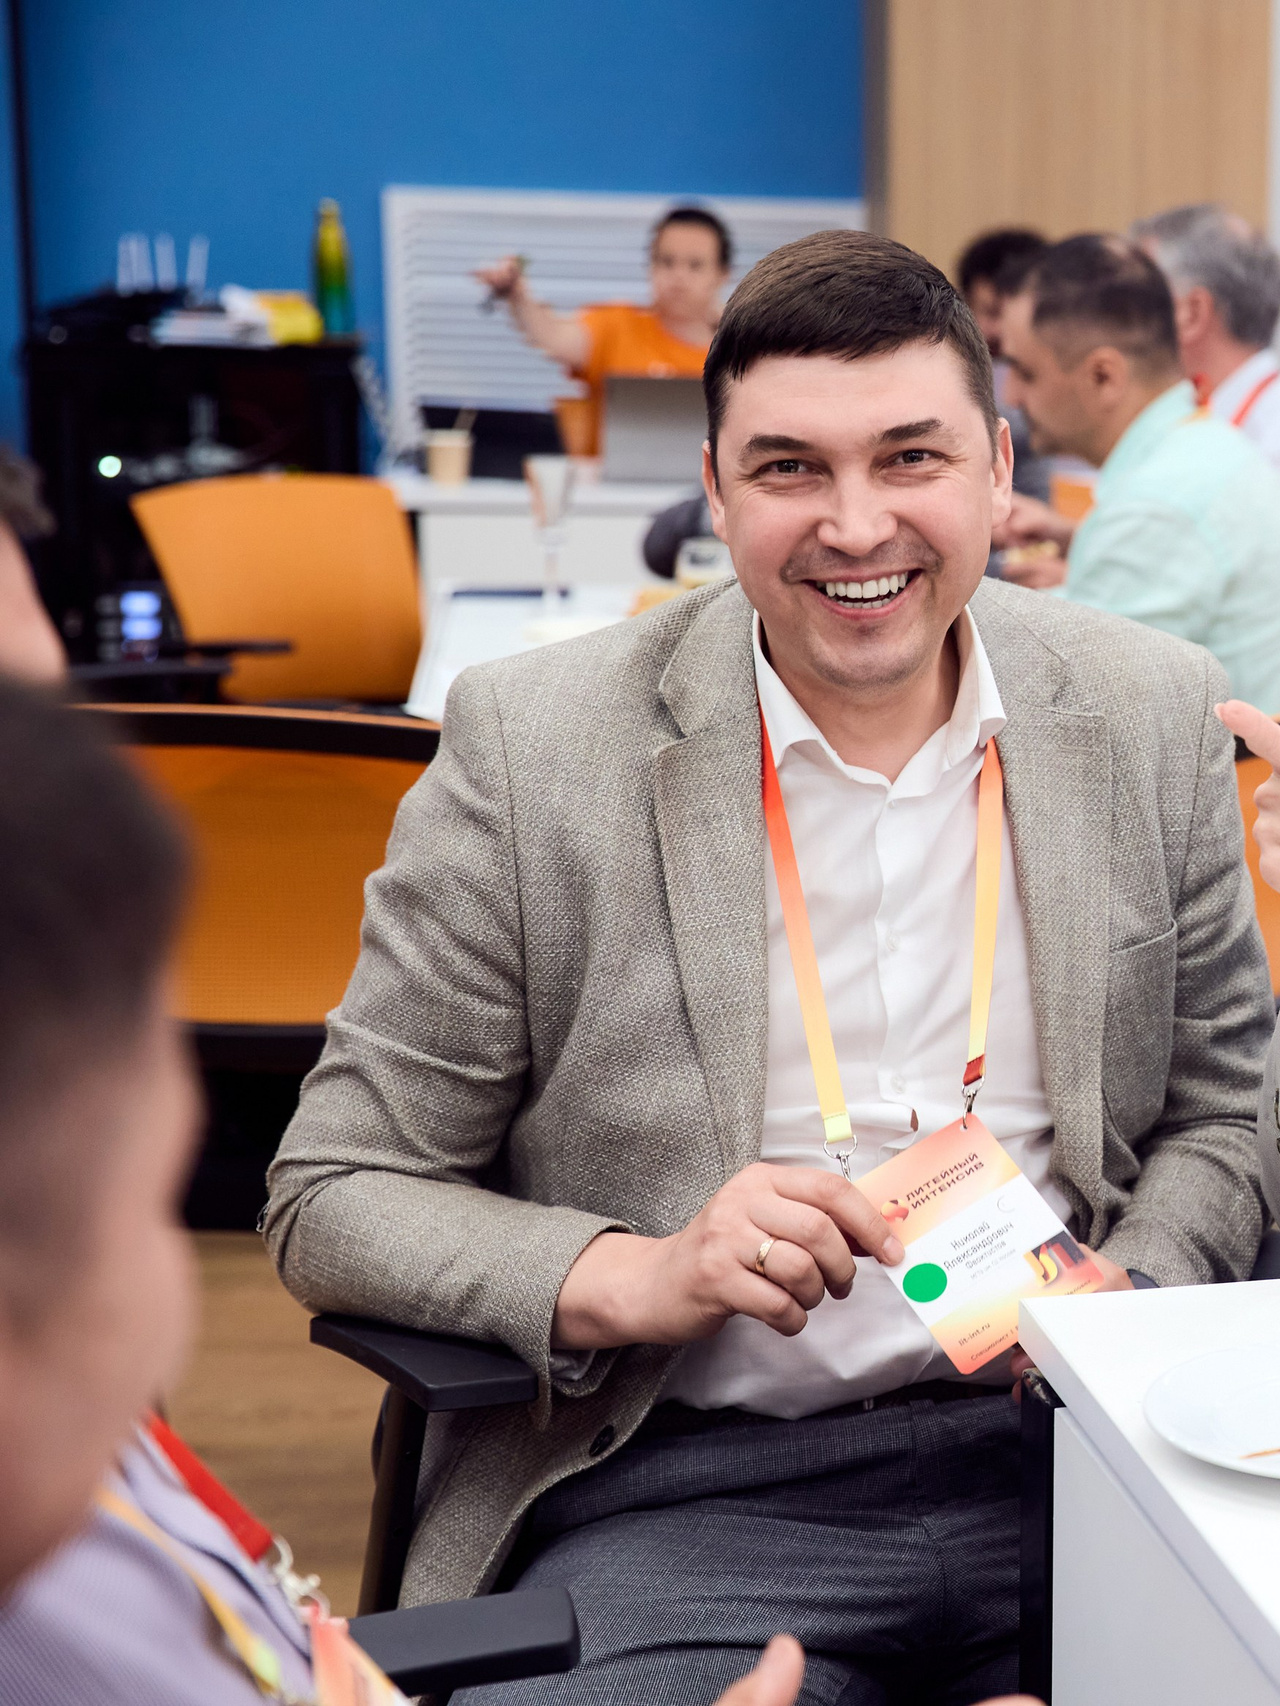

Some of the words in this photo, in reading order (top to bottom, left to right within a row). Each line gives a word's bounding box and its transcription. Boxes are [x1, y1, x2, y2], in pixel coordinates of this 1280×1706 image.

[905, 1152, 979, 1202] ЛИТЕЙНЫЙ
[911, 1161, 985, 1210] ИНТЕНСИВ
[943, 1221, 1014, 1272] Александрович
[950, 1220, 991, 1252] Николай
